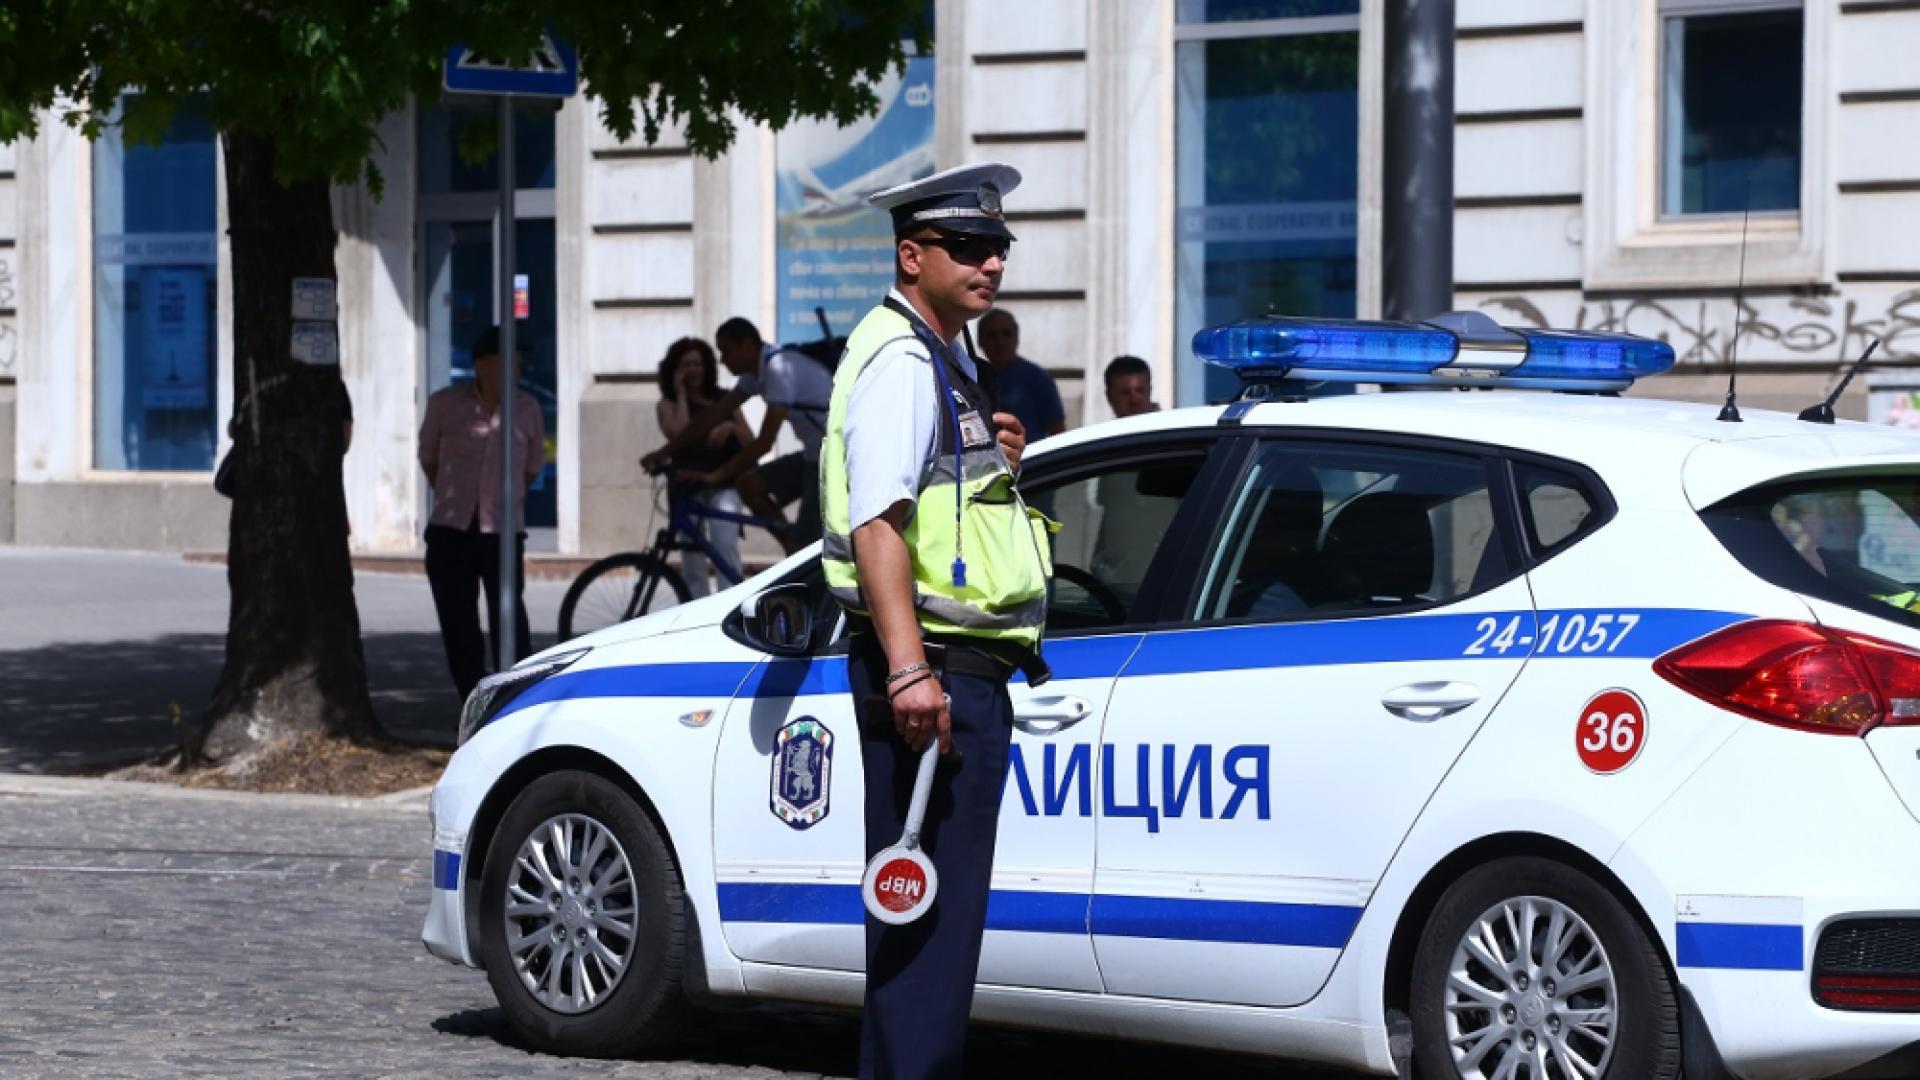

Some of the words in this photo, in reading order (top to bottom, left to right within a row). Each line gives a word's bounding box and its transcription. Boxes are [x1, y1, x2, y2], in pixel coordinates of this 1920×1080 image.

[1463, 613, 1641, 655] 24-1057
[1583, 710, 1637, 753] 36
[1004, 743, 1271, 833] ЛИЦИЯ
[879, 875, 921, 897] МВР
